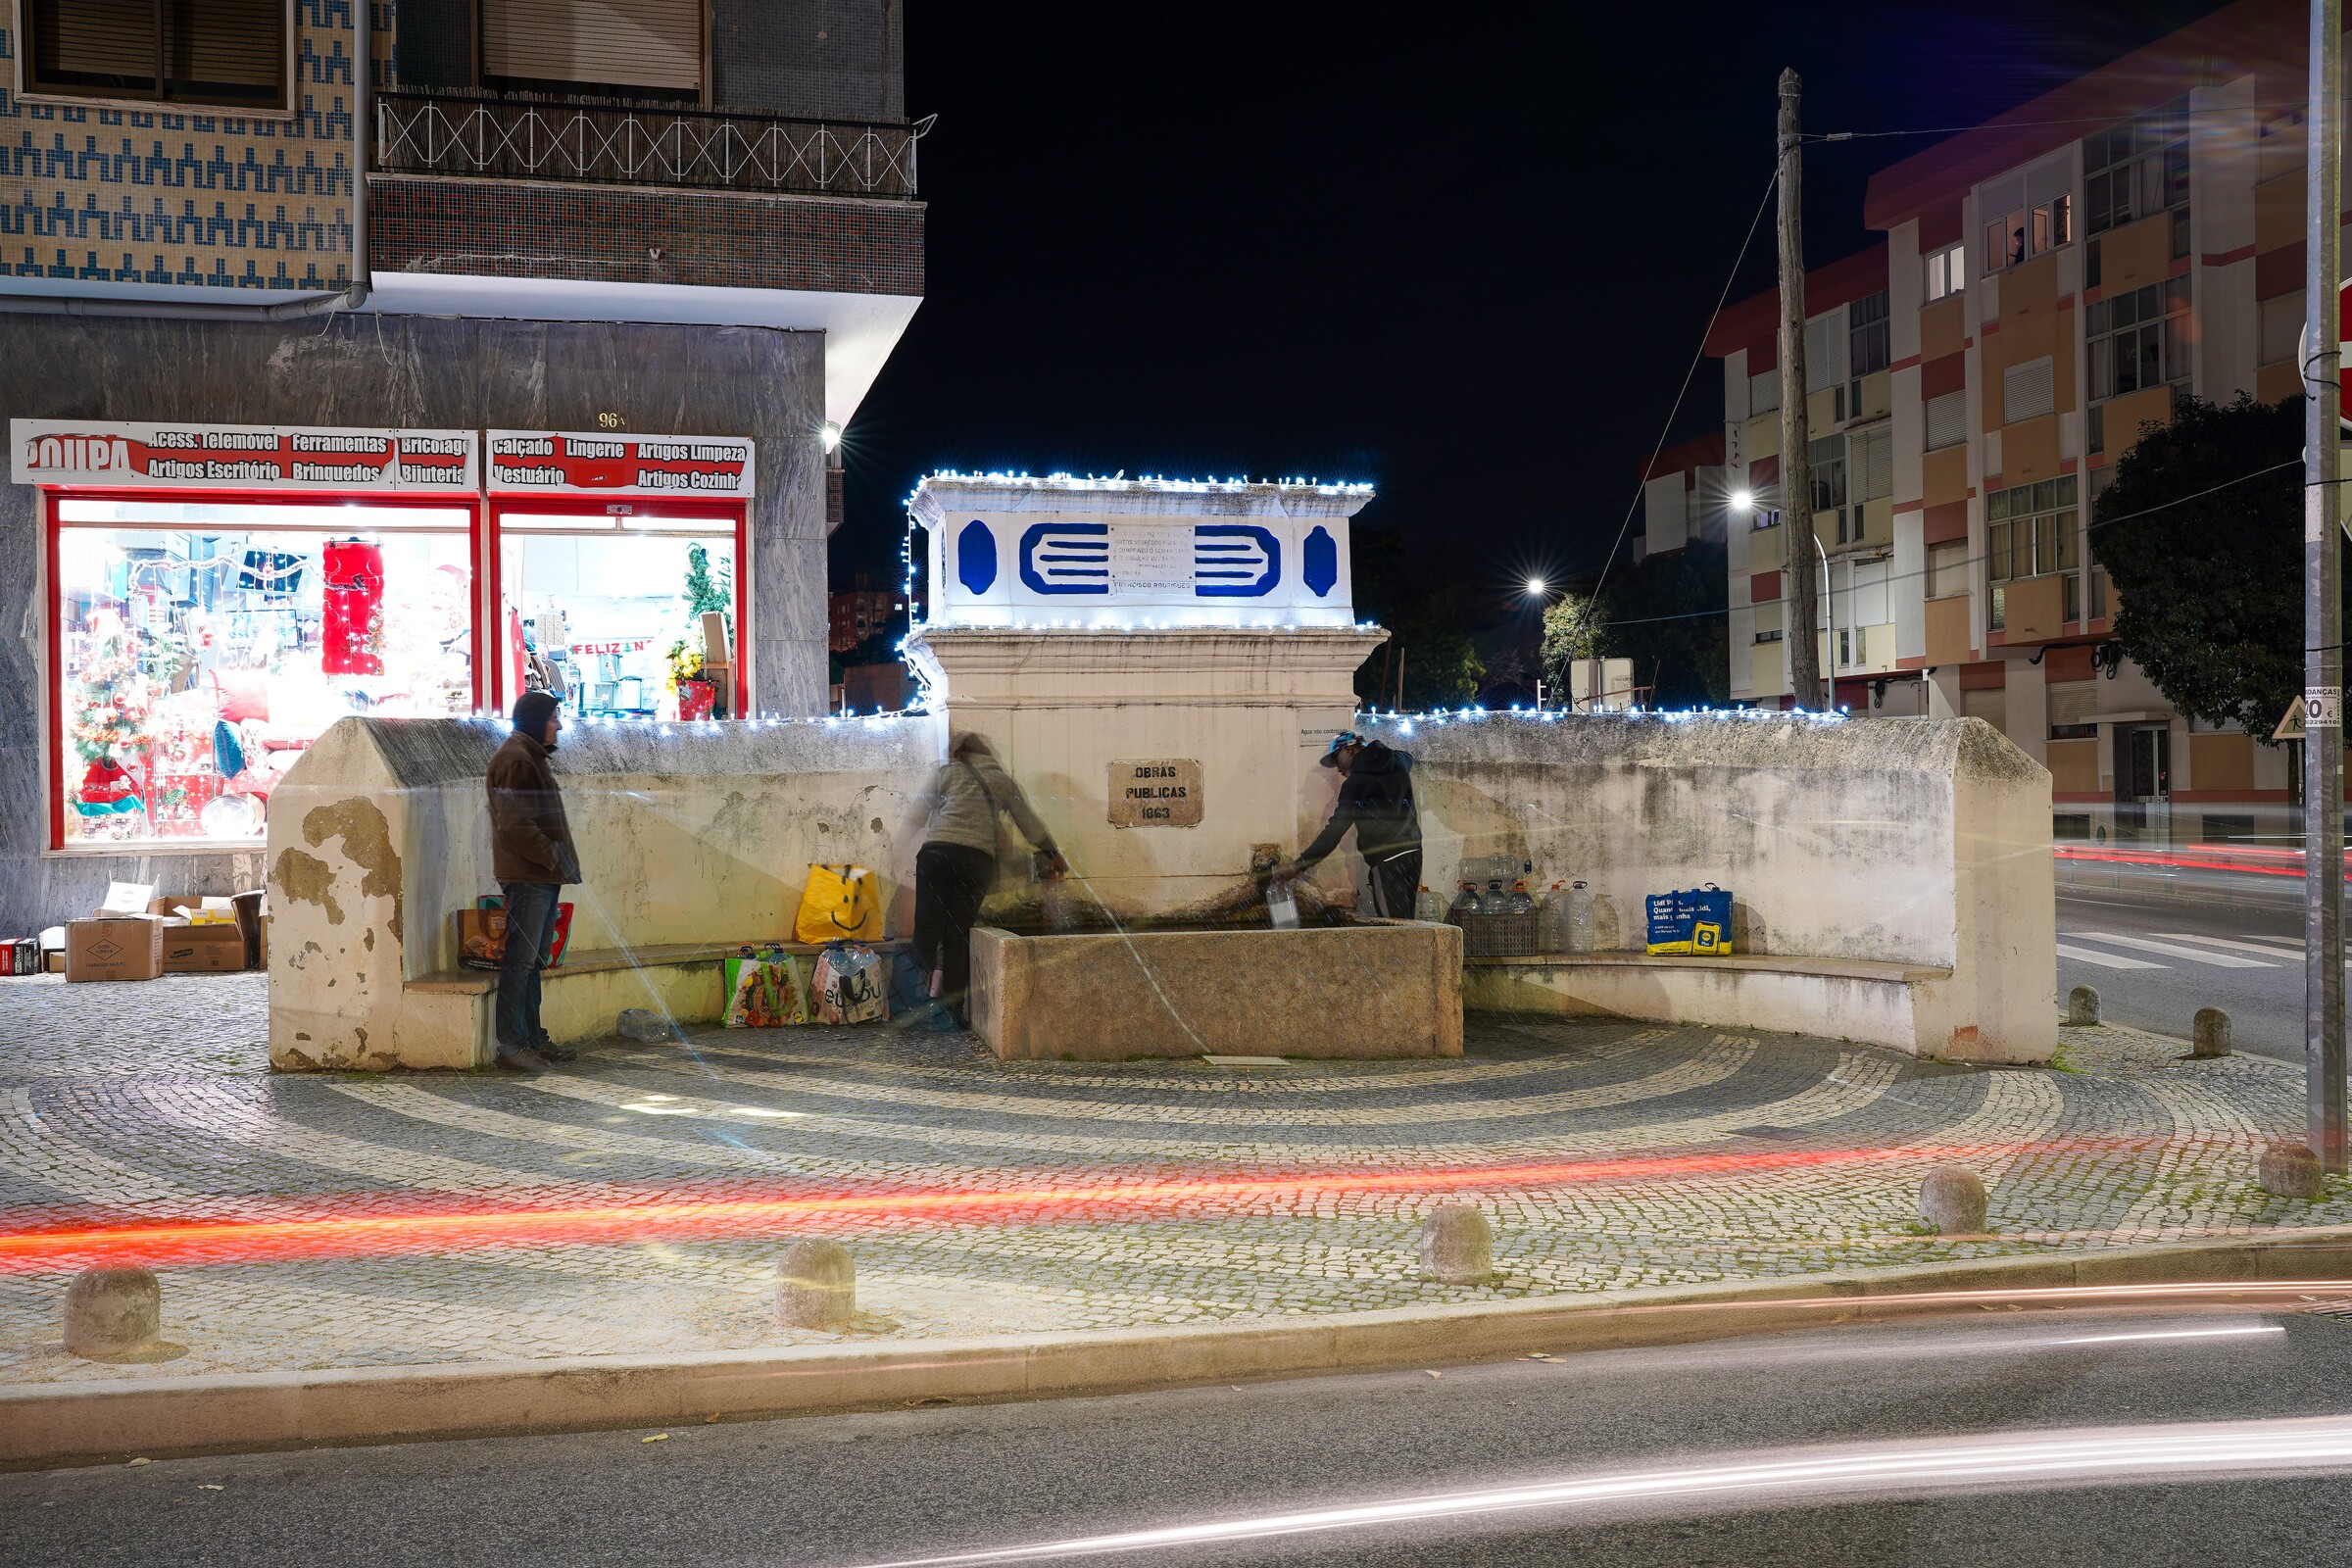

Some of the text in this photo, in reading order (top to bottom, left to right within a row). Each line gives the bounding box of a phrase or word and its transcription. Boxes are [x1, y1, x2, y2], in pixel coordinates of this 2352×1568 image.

[148, 432, 199, 449] Acess.
[292, 434, 387, 453] Ferramentas
[493, 438, 554, 458] Calçado
[565, 439, 625, 459] Lingerie
[637, 443, 746, 463] Artigos Limpeza
[148, 459, 281, 479] Artigos Escritório
[292, 463, 381, 482] Brinquedos
[402, 465, 466, 483] Bijuteria
[493, 465, 565, 484] Vestuário
[638, 469, 688, 488] Artigos
[572, 642, 620, 655] FELIZ
[1135, 766, 1176, 778] OBRAS
[1126, 786, 1187, 799] PUBLICAS
[1142, 807, 1170, 819] 1863
